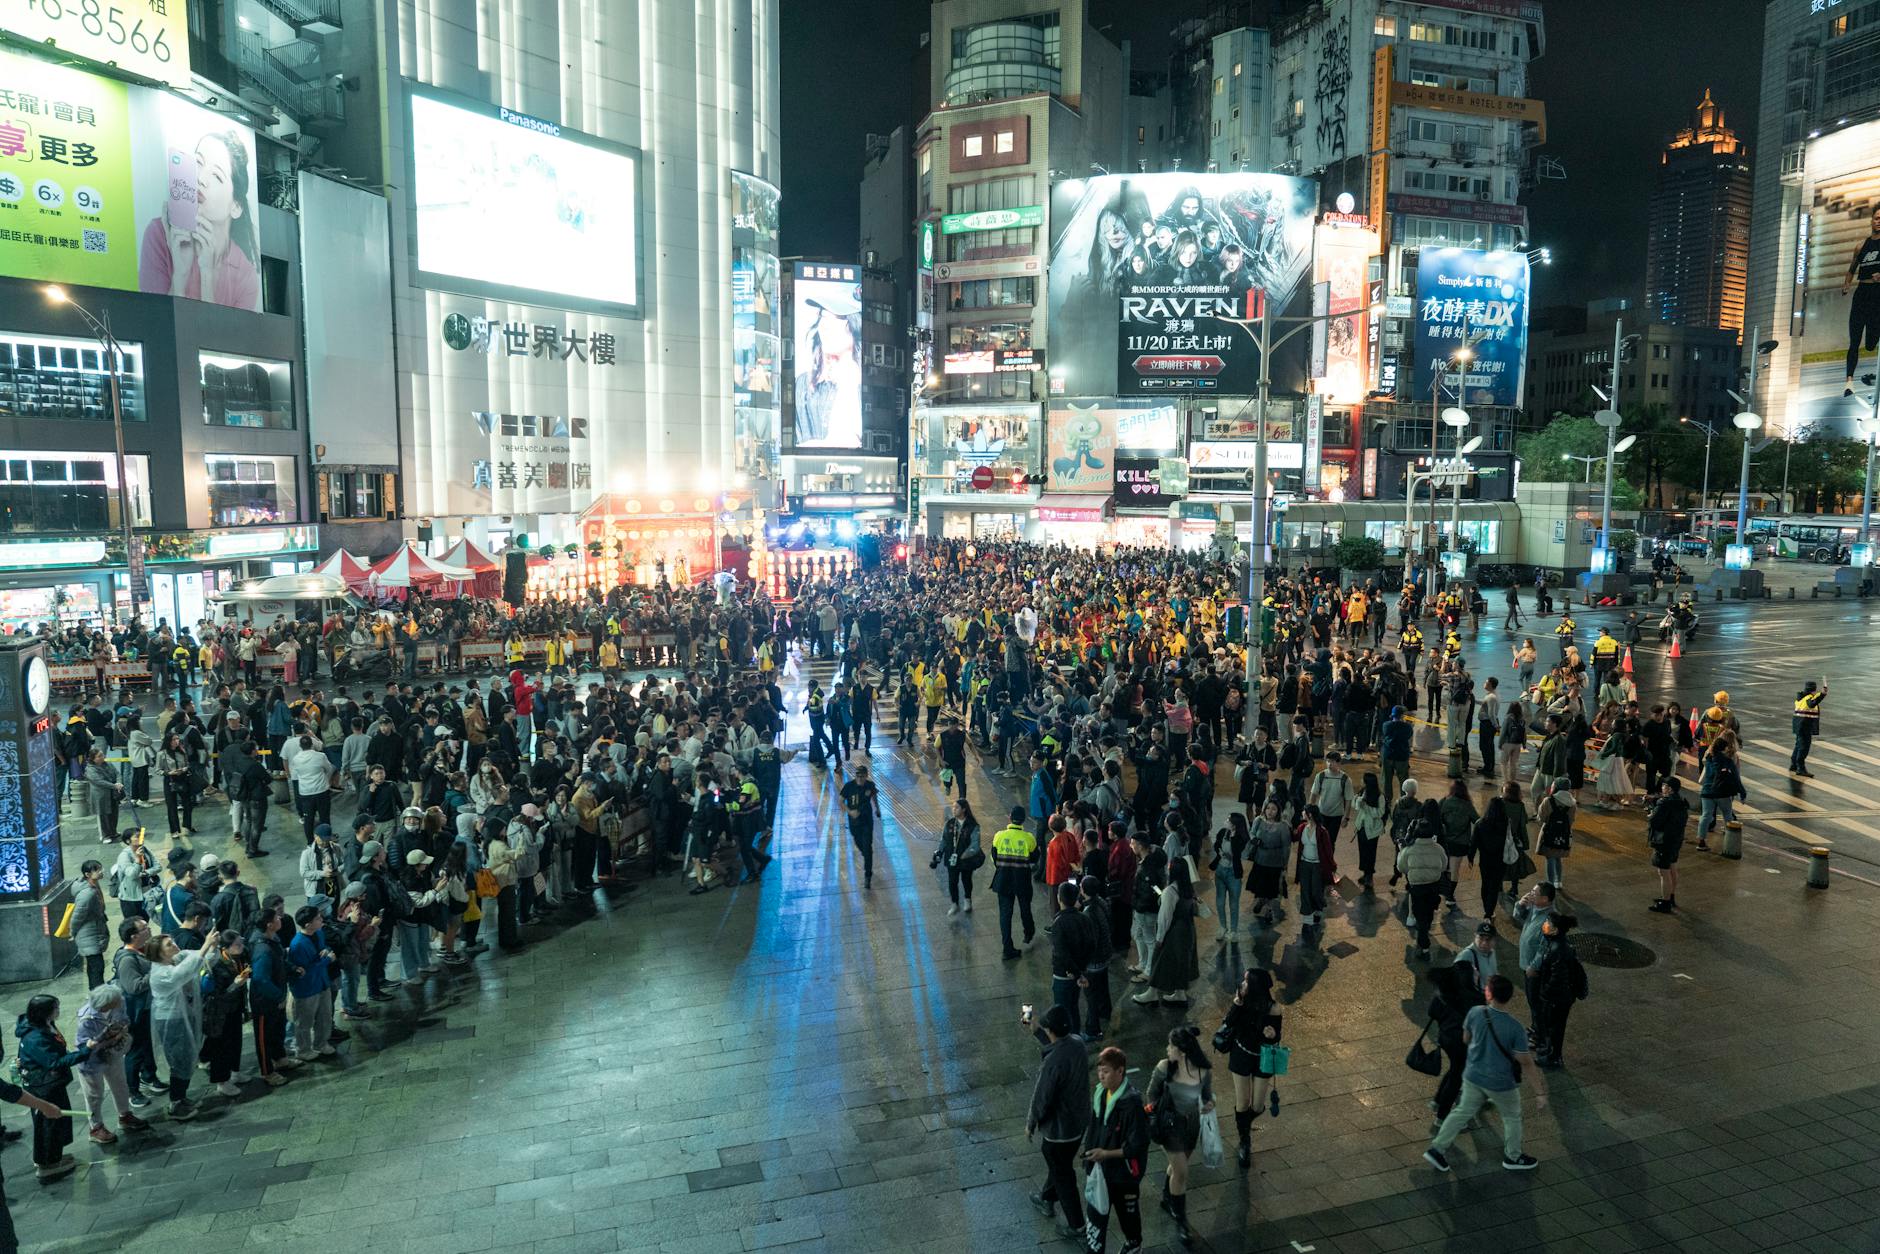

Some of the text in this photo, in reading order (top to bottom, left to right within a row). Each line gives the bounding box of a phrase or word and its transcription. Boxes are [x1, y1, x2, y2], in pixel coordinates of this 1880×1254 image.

[500, 107, 560, 137] Panasonic
[39, 134, 99, 167] 更多
[1438, 274, 1464, 288] Simply
[1120, 297, 1240, 324] RAVEN
[1164, 318, 1195, 333] 渡鴉
[471, 315, 616, 366] 新世界大樓
[1127, 336, 1232, 350] 11/20 正式上市!
[1150, 360, 1202, 370] 立即前往下載
